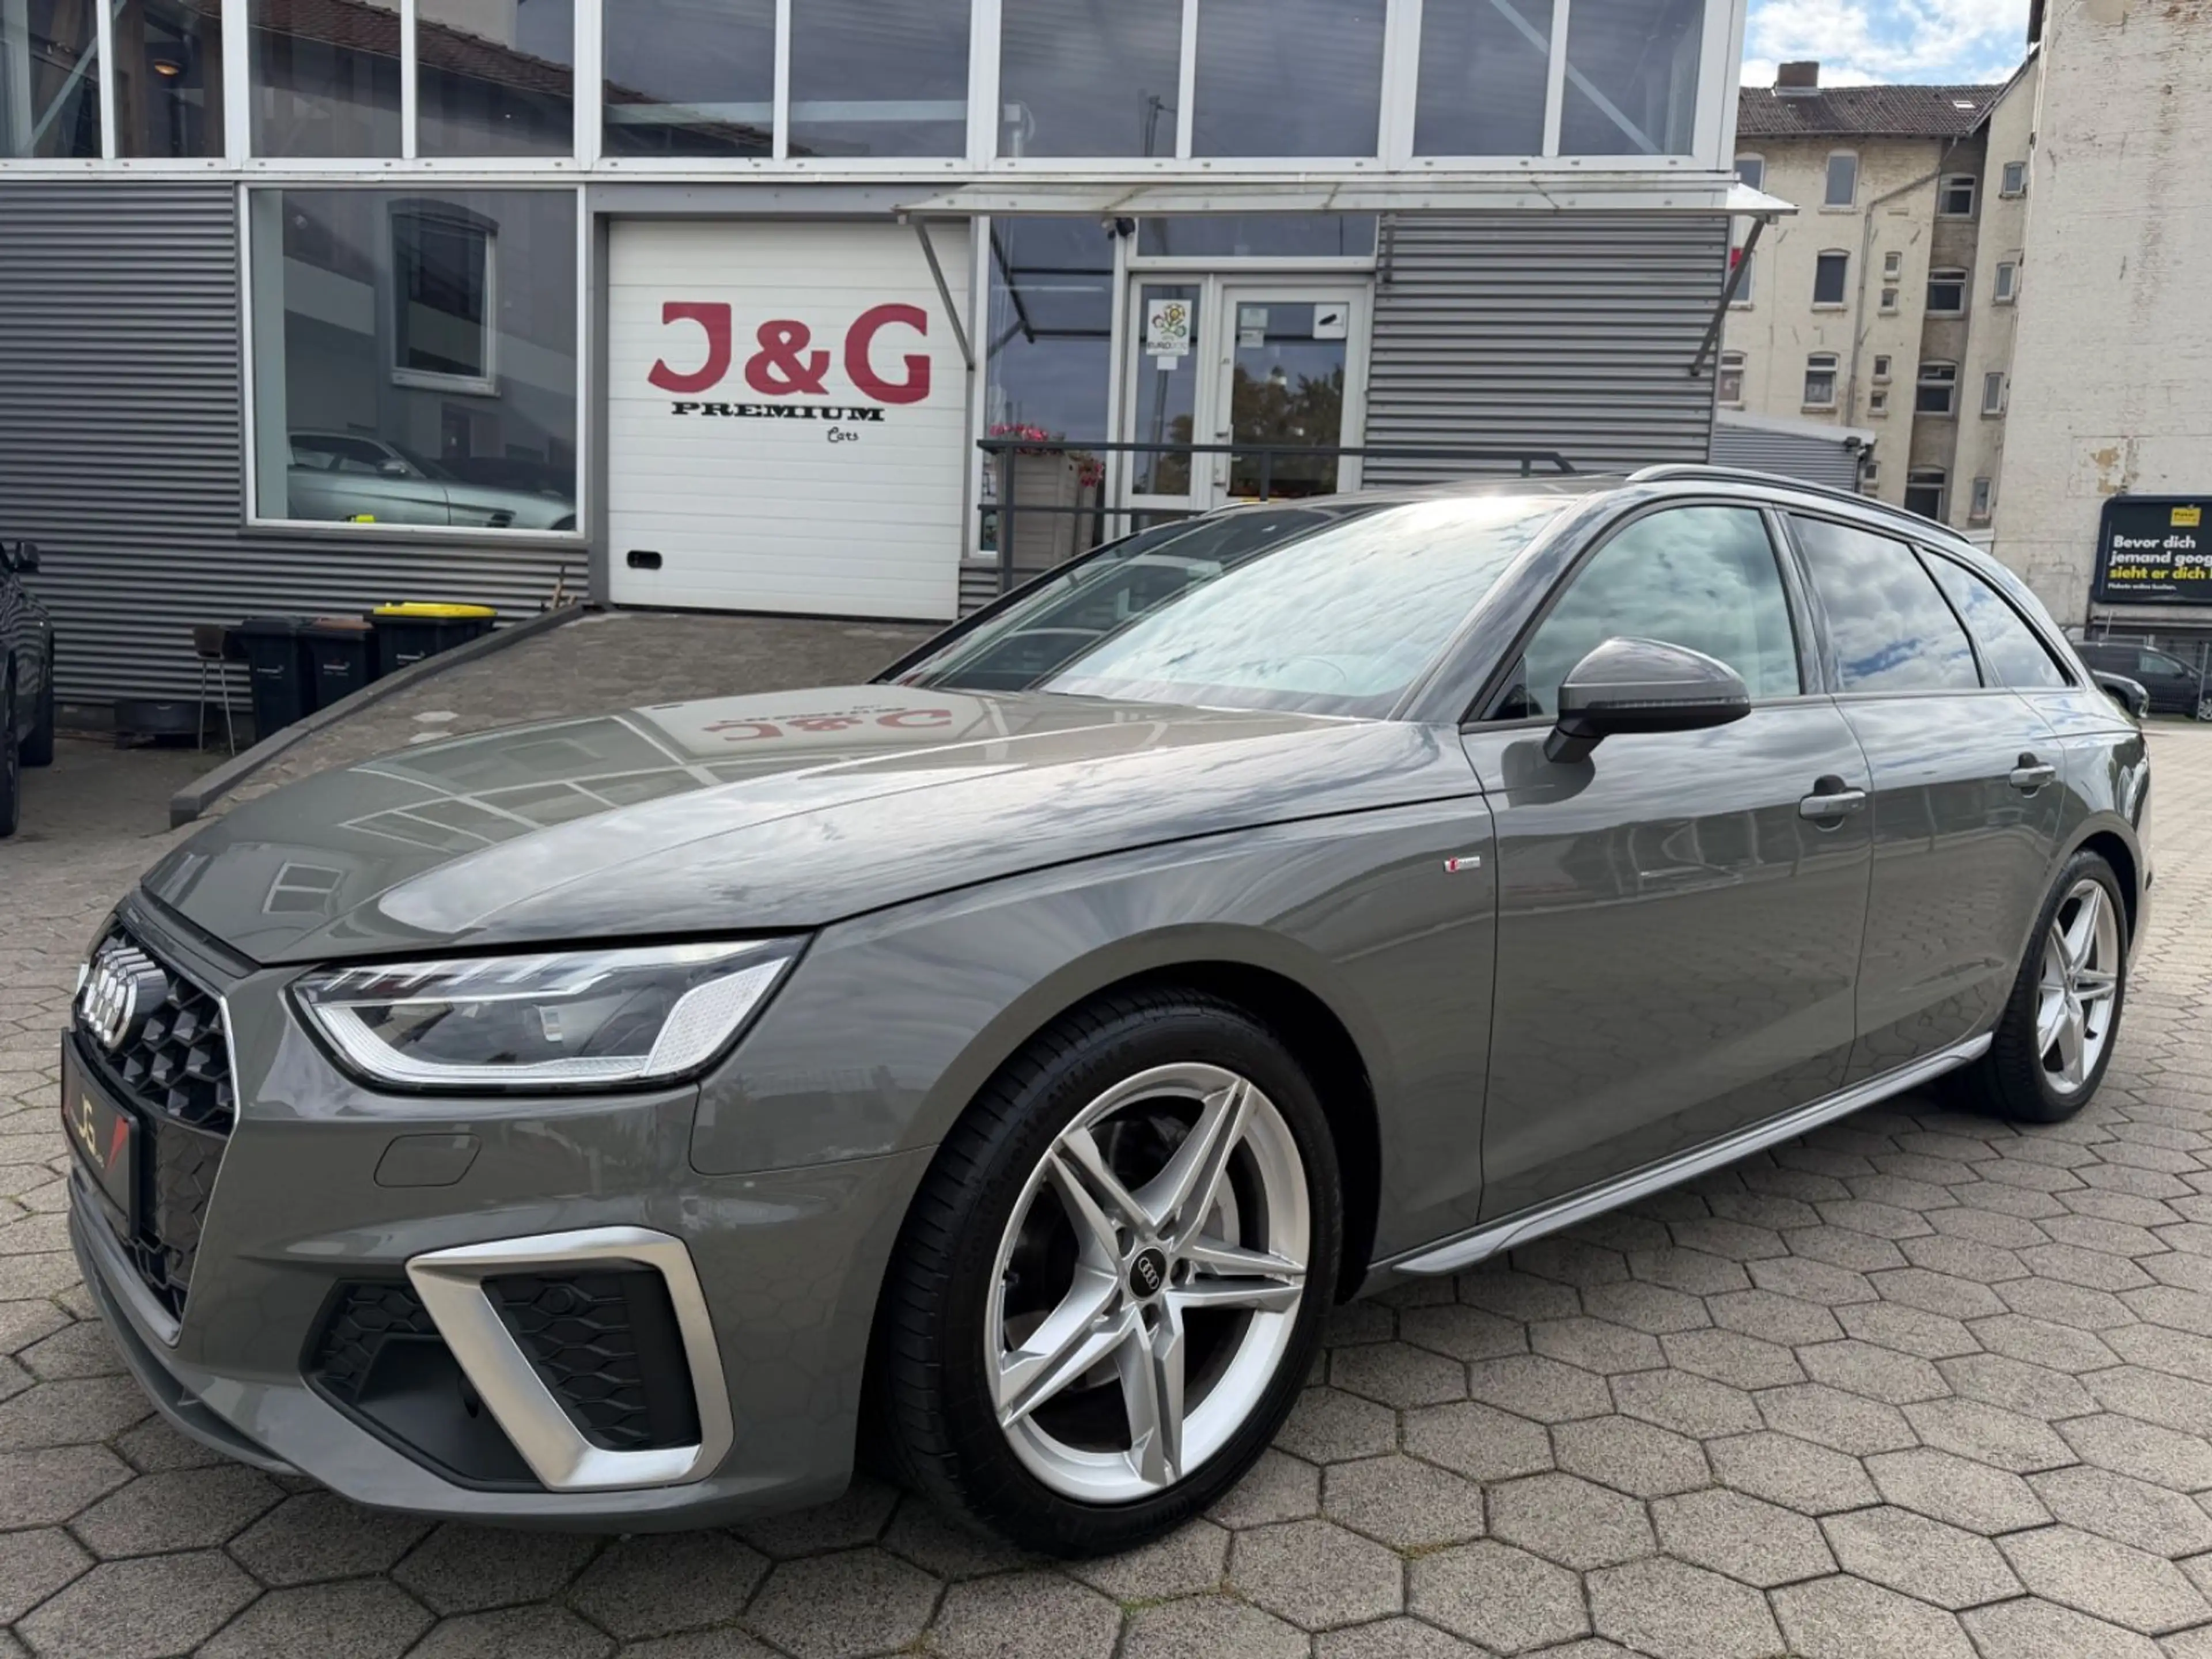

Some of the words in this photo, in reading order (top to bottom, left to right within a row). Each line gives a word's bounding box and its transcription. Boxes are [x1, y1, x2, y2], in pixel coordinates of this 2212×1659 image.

[671, 402, 885, 422] PREMIUM
[827, 426, 859, 443] Cars
[2113, 535, 2160, 548] Bevor
[2163, 535, 2196, 548] dich
[2109, 551, 2172, 566] jemand
[2109, 565, 2148, 579] sieht
[2151, 569, 2169, 579] er
[2172, 566, 2206, 579] dich
